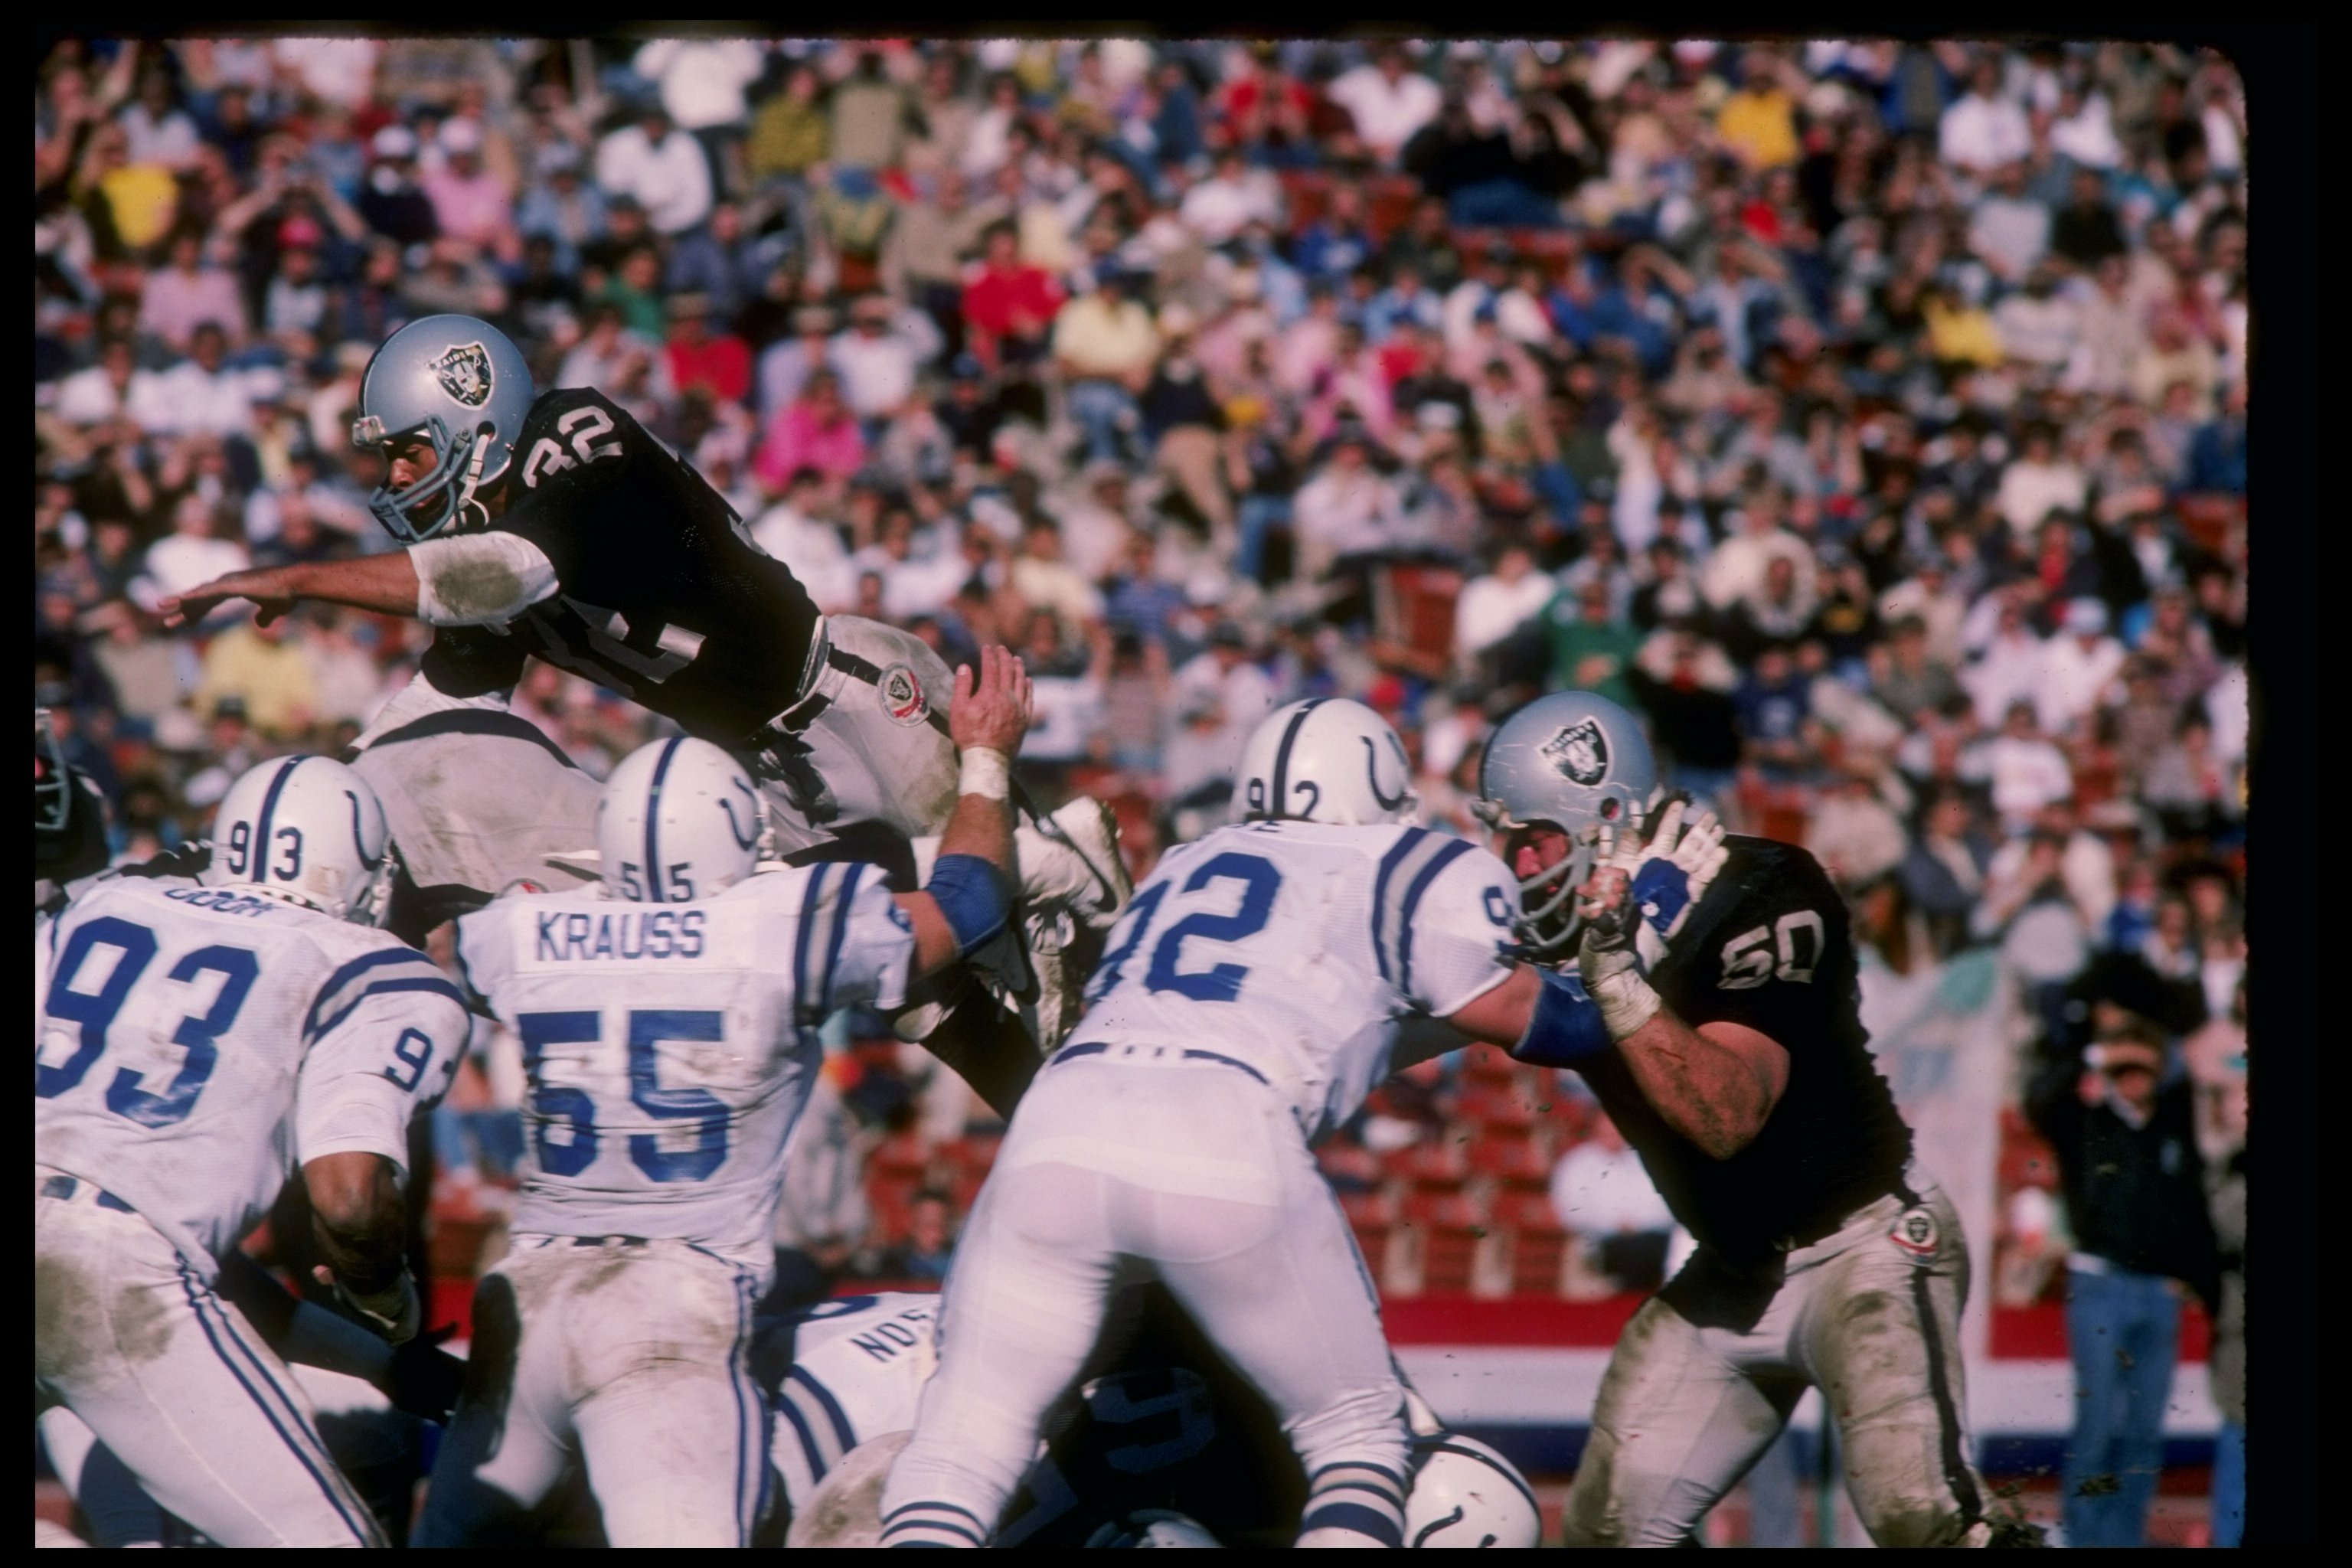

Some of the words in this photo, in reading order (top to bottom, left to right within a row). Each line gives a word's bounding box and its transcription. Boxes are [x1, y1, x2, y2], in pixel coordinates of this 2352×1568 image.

[521, 406, 622, 488] 32
[537, 911, 707, 961] KRAUSS
[1717, 910, 1824, 989] 50
[36, 916, 260, 1129] 93
[518, 1010, 730, 1184] 55
